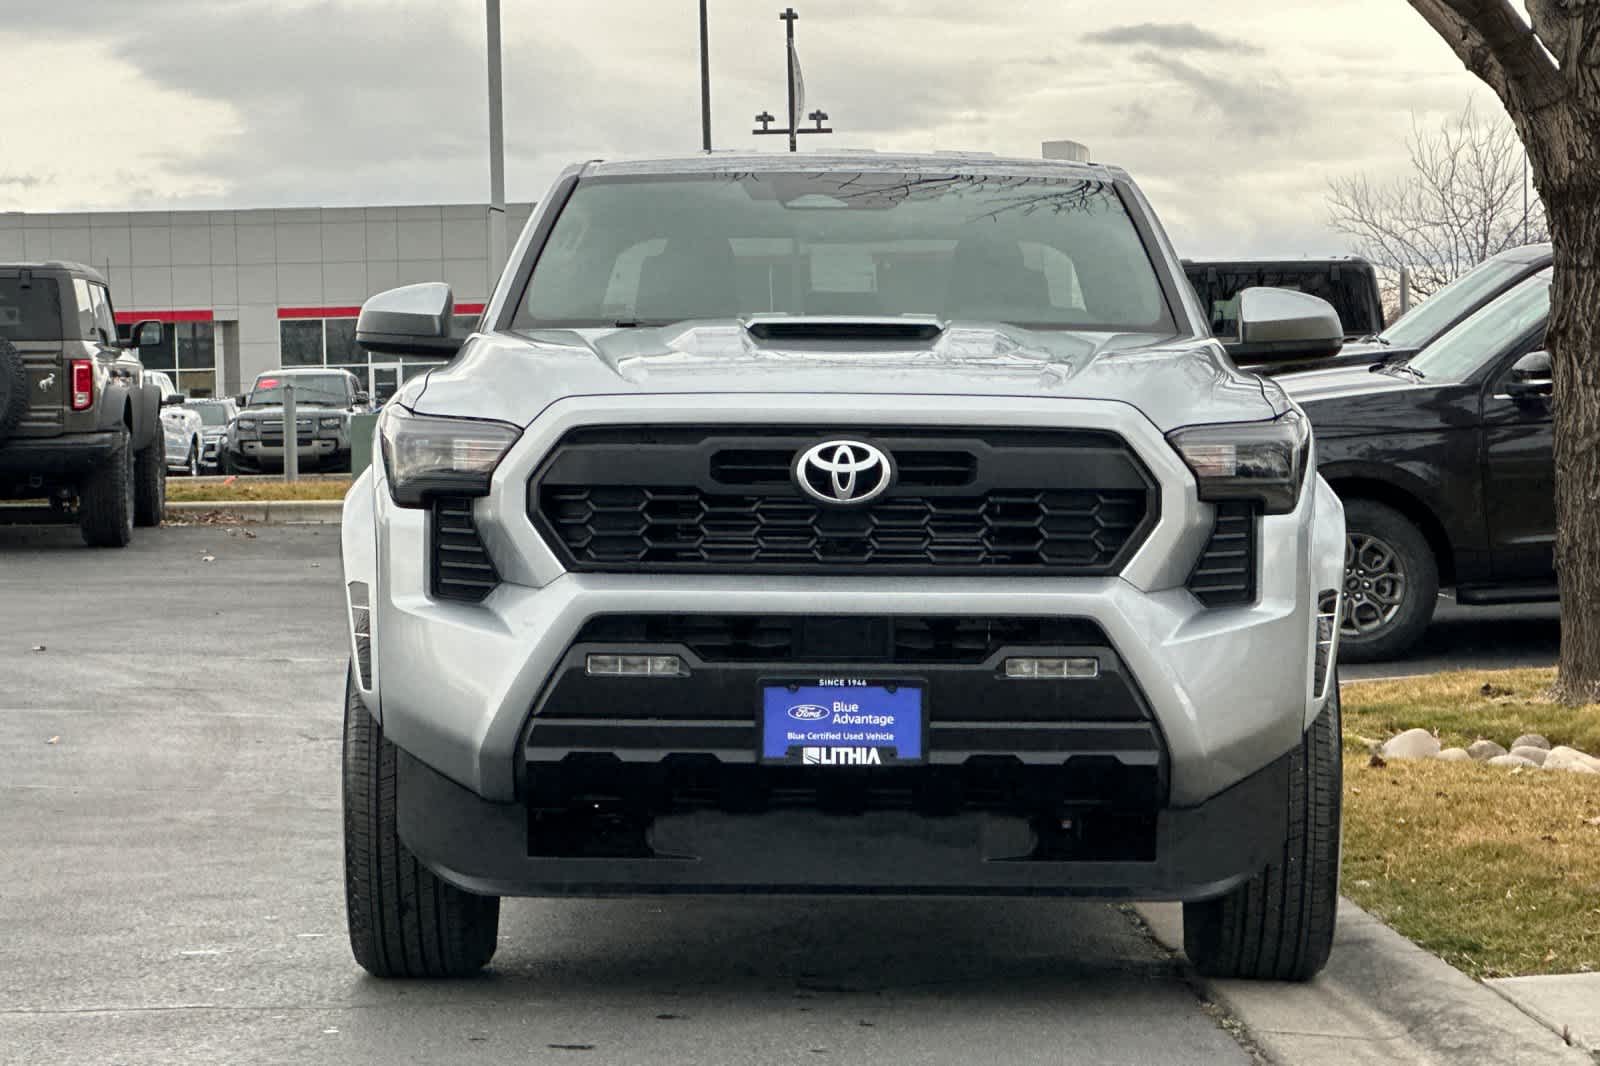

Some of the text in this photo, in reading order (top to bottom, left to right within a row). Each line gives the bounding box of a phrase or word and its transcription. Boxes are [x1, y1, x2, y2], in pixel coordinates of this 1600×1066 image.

[819, 679, 867, 687] SINCE 1946
[795, 706, 822, 719] Ford
[833, 702, 859, 712] Blue
[832, 714, 895, 726] Advantage
[788, 732, 894, 740] Blue Certified Used Vehicle
[820, 747, 881, 765] LITHIA
